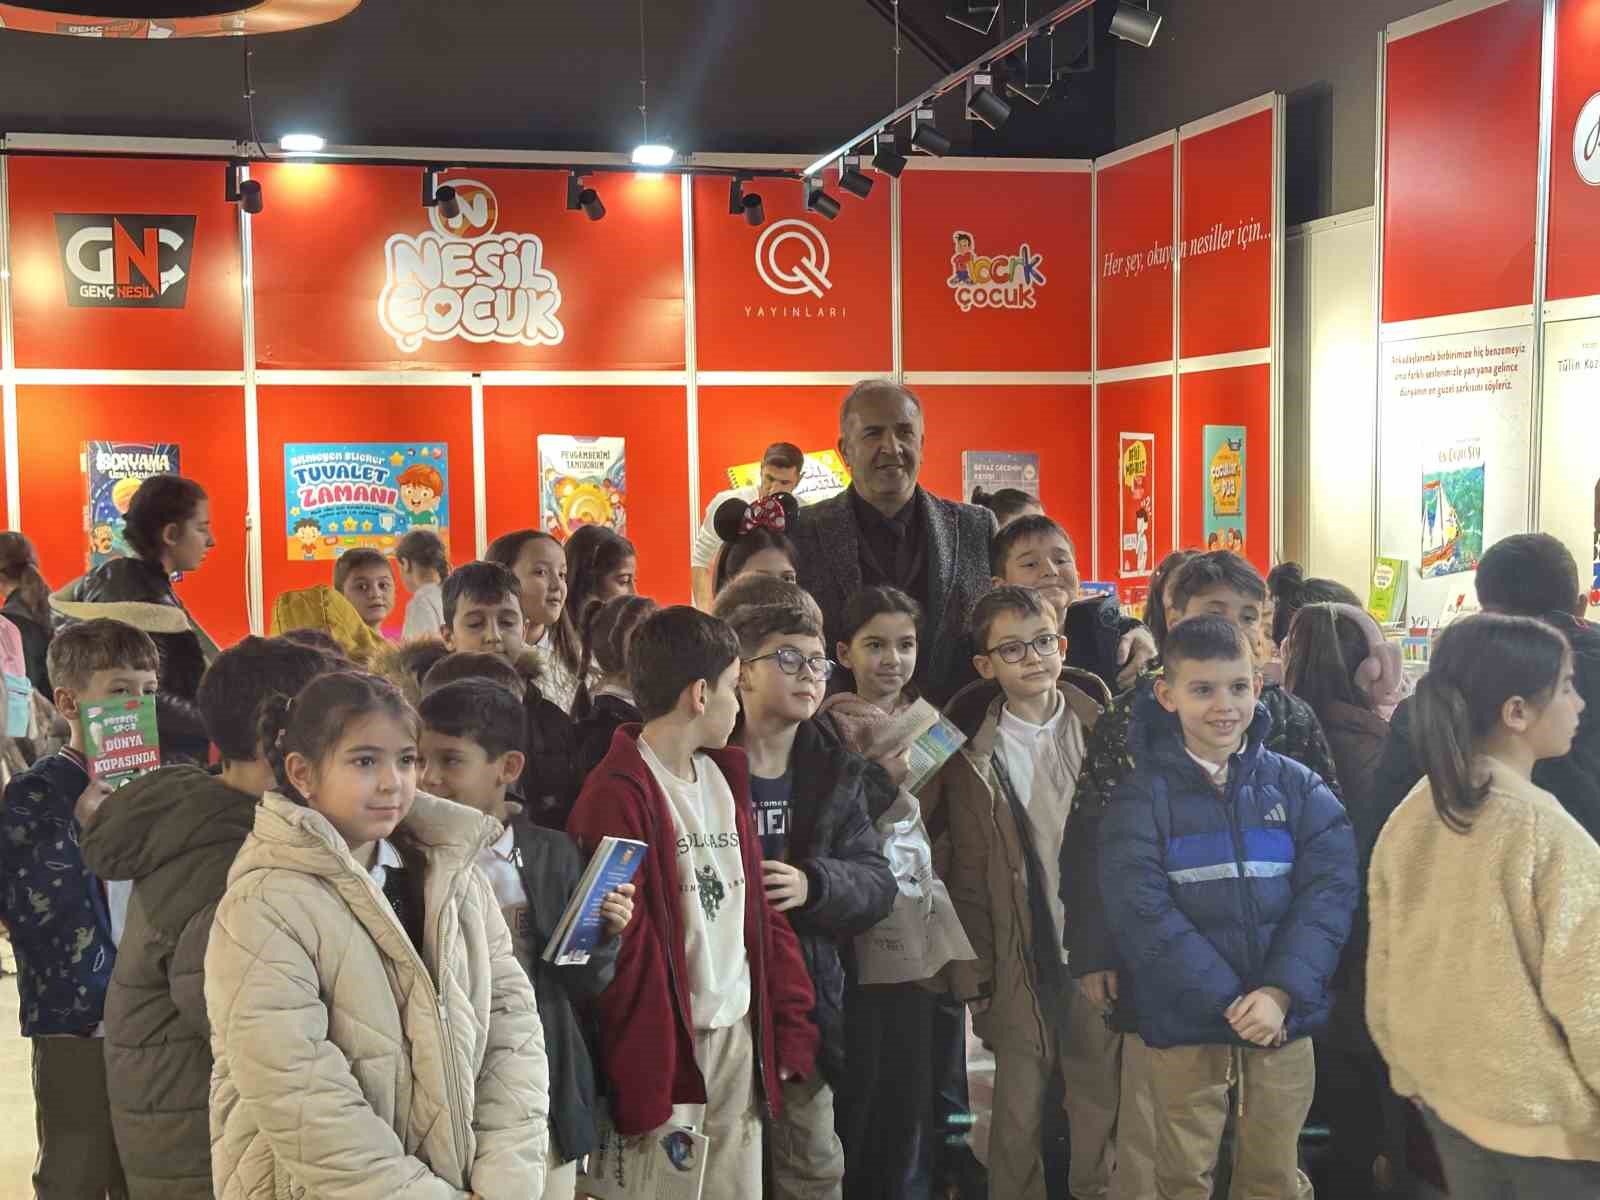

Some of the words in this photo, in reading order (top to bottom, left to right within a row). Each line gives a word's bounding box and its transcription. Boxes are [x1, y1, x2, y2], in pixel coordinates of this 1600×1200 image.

[1103, 252, 1125, 278] Her
[1125, 249, 1145, 277] şey,
[1190, 222, 1235, 257] nesiller
[1237, 217, 1271, 251] için...
[79, 285, 115, 301] GENÇ
[386, 283, 560, 350] ÇOCUK
[744, 305, 847, 319] YAYINLARI
[1473, 343, 1484, 359] hiç
[1493, 360, 1519, 376] gelince
[293, 463, 389, 485] TUVALET
[299, 484, 398, 508] ZAMANI
[94, 750, 157, 774] KUPASINDA
